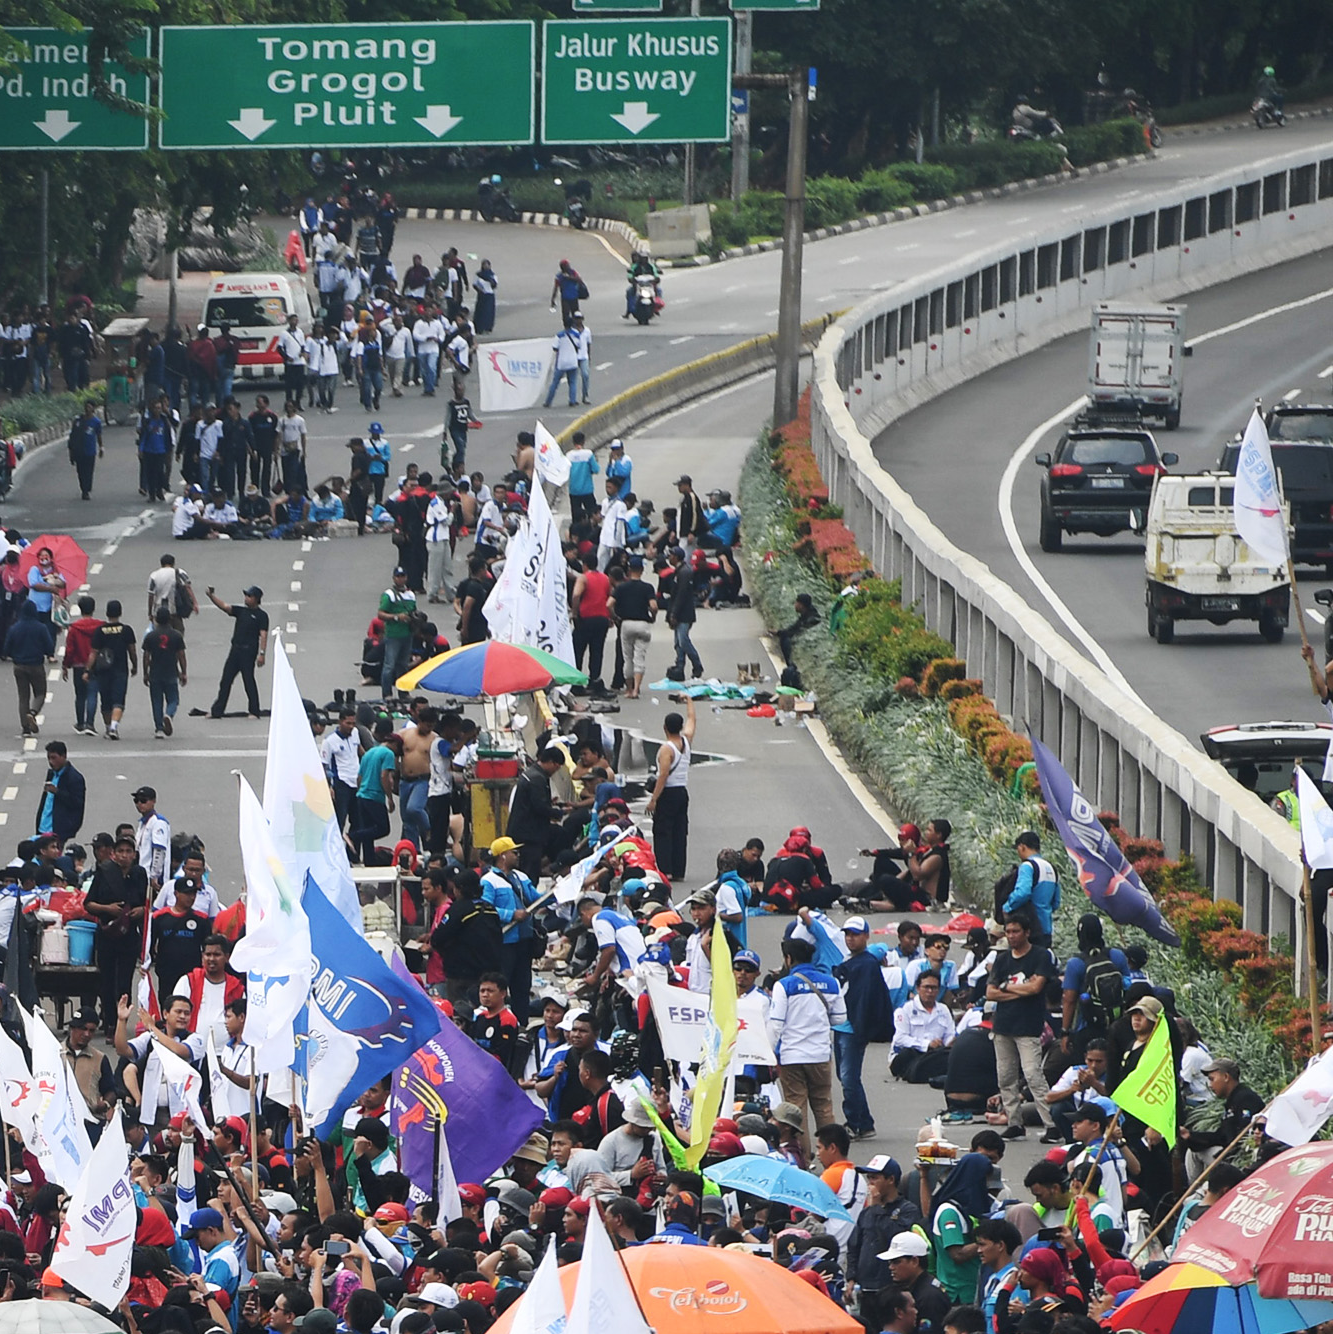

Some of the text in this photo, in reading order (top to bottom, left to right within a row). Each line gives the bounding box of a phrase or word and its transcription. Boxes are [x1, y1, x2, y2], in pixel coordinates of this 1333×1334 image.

[258, 38, 436, 72] Tomang
[554, 32, 720, 58] Jalur Khusus
[43, 73, 127, 97] Indh
[267, 69, 425, 98] Grogol
[575, 69, 697, 96] Busway
[294, 99, 397, 126] Pluit
[426, 1037, 455, 1083] KOMPONEN
[1218, 1192, 1284, 1226] pucuk
[1287, 1271, 1332, 1284] Rasa Teh
[1287, 1283, 1317, 1297] ada di
